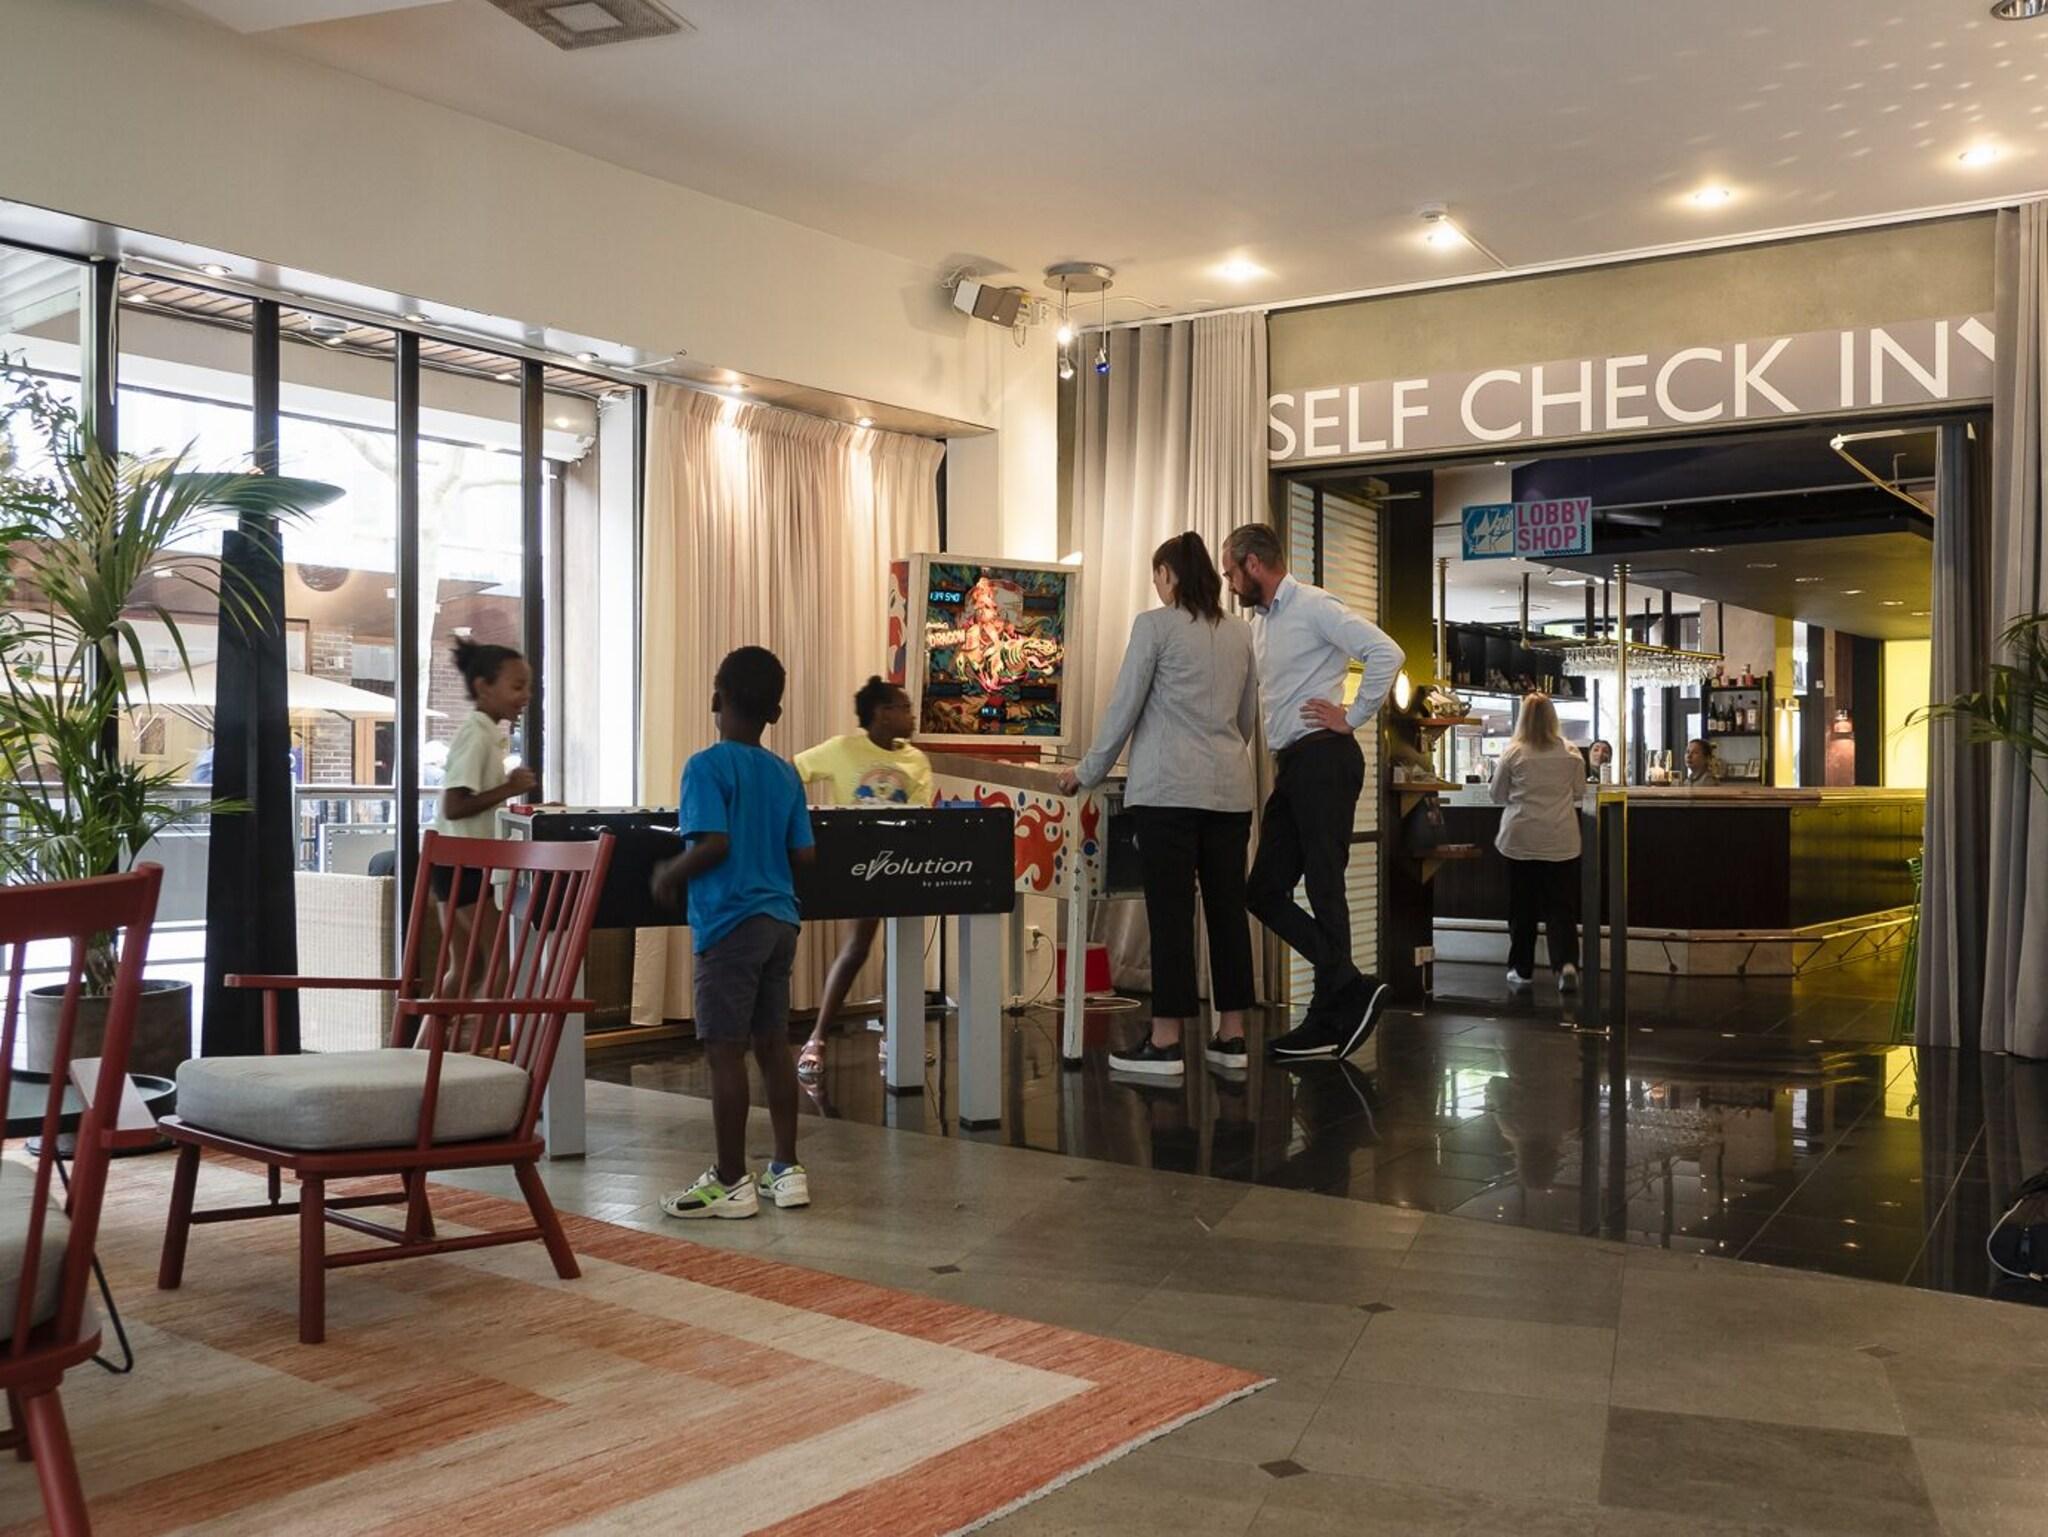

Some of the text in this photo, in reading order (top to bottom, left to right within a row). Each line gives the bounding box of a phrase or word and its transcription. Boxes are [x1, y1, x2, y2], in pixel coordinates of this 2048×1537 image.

[1268, 320, 1949, 461] SELF CHECK IN
[1517, 499, 1589, 527] LOBBY
[1517, 525, 1577, 551] SHOP
